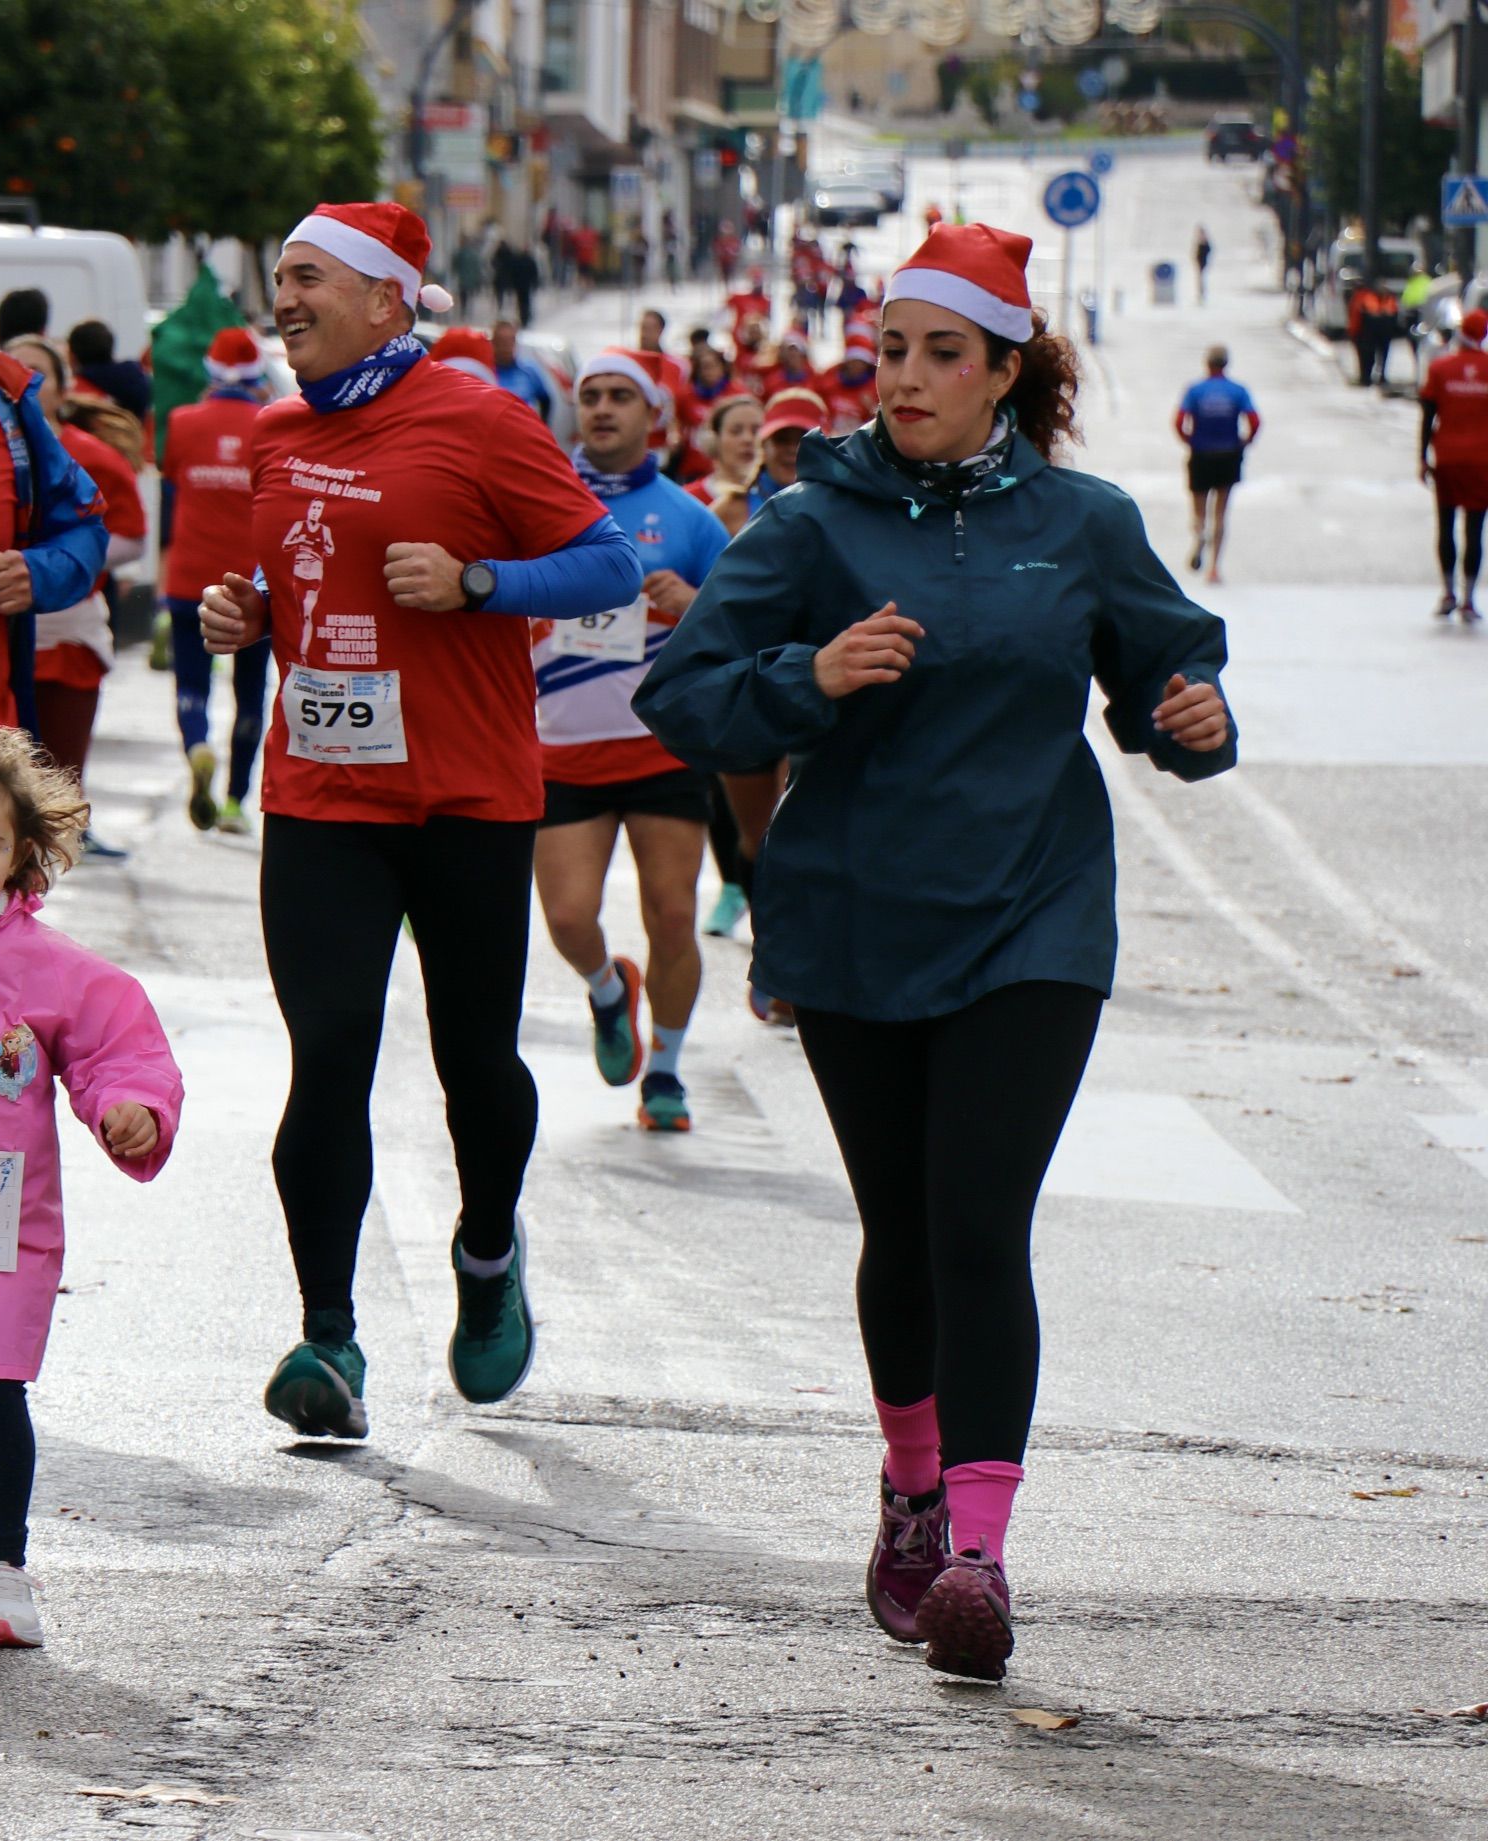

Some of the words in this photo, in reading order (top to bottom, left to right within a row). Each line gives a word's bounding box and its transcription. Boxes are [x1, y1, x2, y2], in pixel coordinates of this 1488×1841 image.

[289, 458, 312, 472] San
[308, 463, 356, 482] Silvestre
[291, 472, 328, 493] Ciudad
[327, 481, 343, 496] de
[342, 483, 382, 503] Lucena
[325, 614, 377, 627] MEMORIAL
[316, 627, 336, 640] JOSE
[338, 628, 377, 640] CARLOS
[330, 640, 378, 652] HURTADO
[325, 652, 378, 665] MARJALIZO
[300, 698, 374, 728] 579
[357, 743, 393, 751] enerplus
